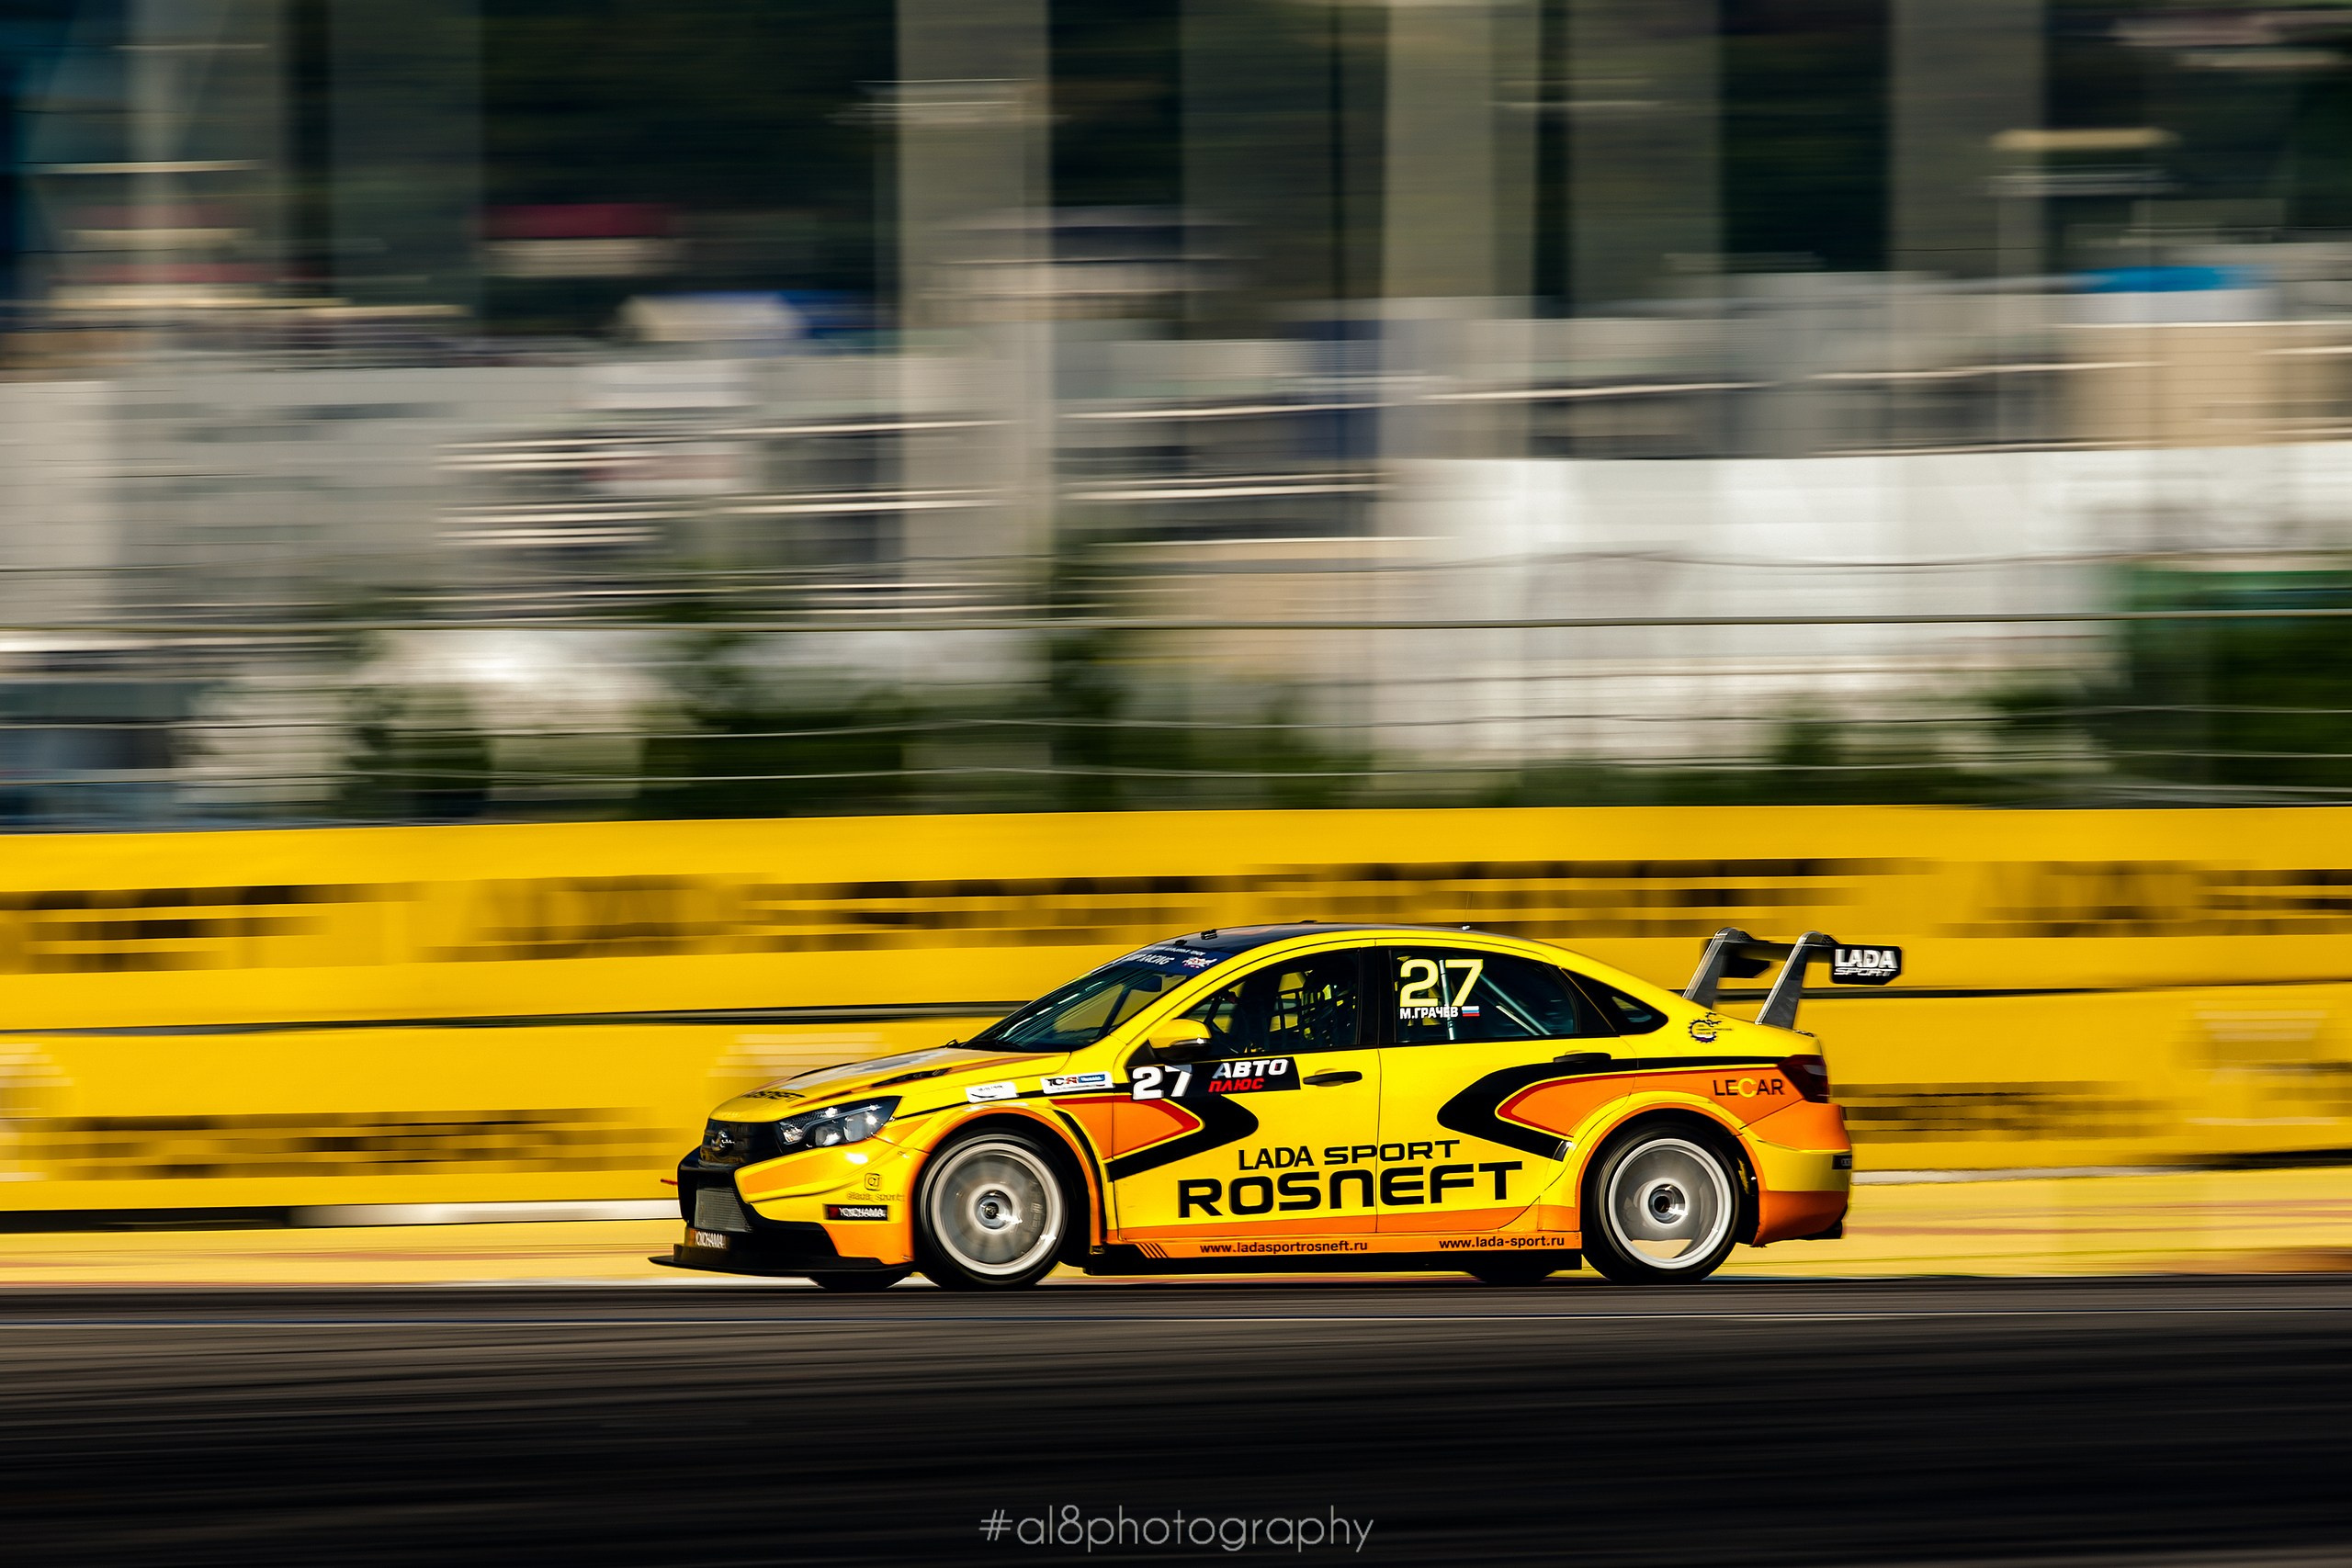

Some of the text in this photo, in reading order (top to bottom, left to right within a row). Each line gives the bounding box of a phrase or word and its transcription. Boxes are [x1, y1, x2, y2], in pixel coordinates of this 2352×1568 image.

[1835, 949, 1898, 968] LADA
[1834, 967, 1896, 976] SPORT
[1399, 958, 1484, 1007] 27
[1212, 1058, 1289, 1079] АВТО
[1132, 1064, 1193, 1100] 27
[1208, 1077, 1265, 1093] ПЛЮС
[1713, 1077, 1785, 1098] LECAR
[1238, 1139, 1460, 1170] LADA SPORT
[1178, 1161, 1523, 1218] ROSNEFT
[839, 1208, 887, 1218] YOKOHAMA
[1200, 1241, 1368, 1255] www.ladasportrosneft.ru
[1440, 1235, 1565, 1248] www.lada-sport.ru
